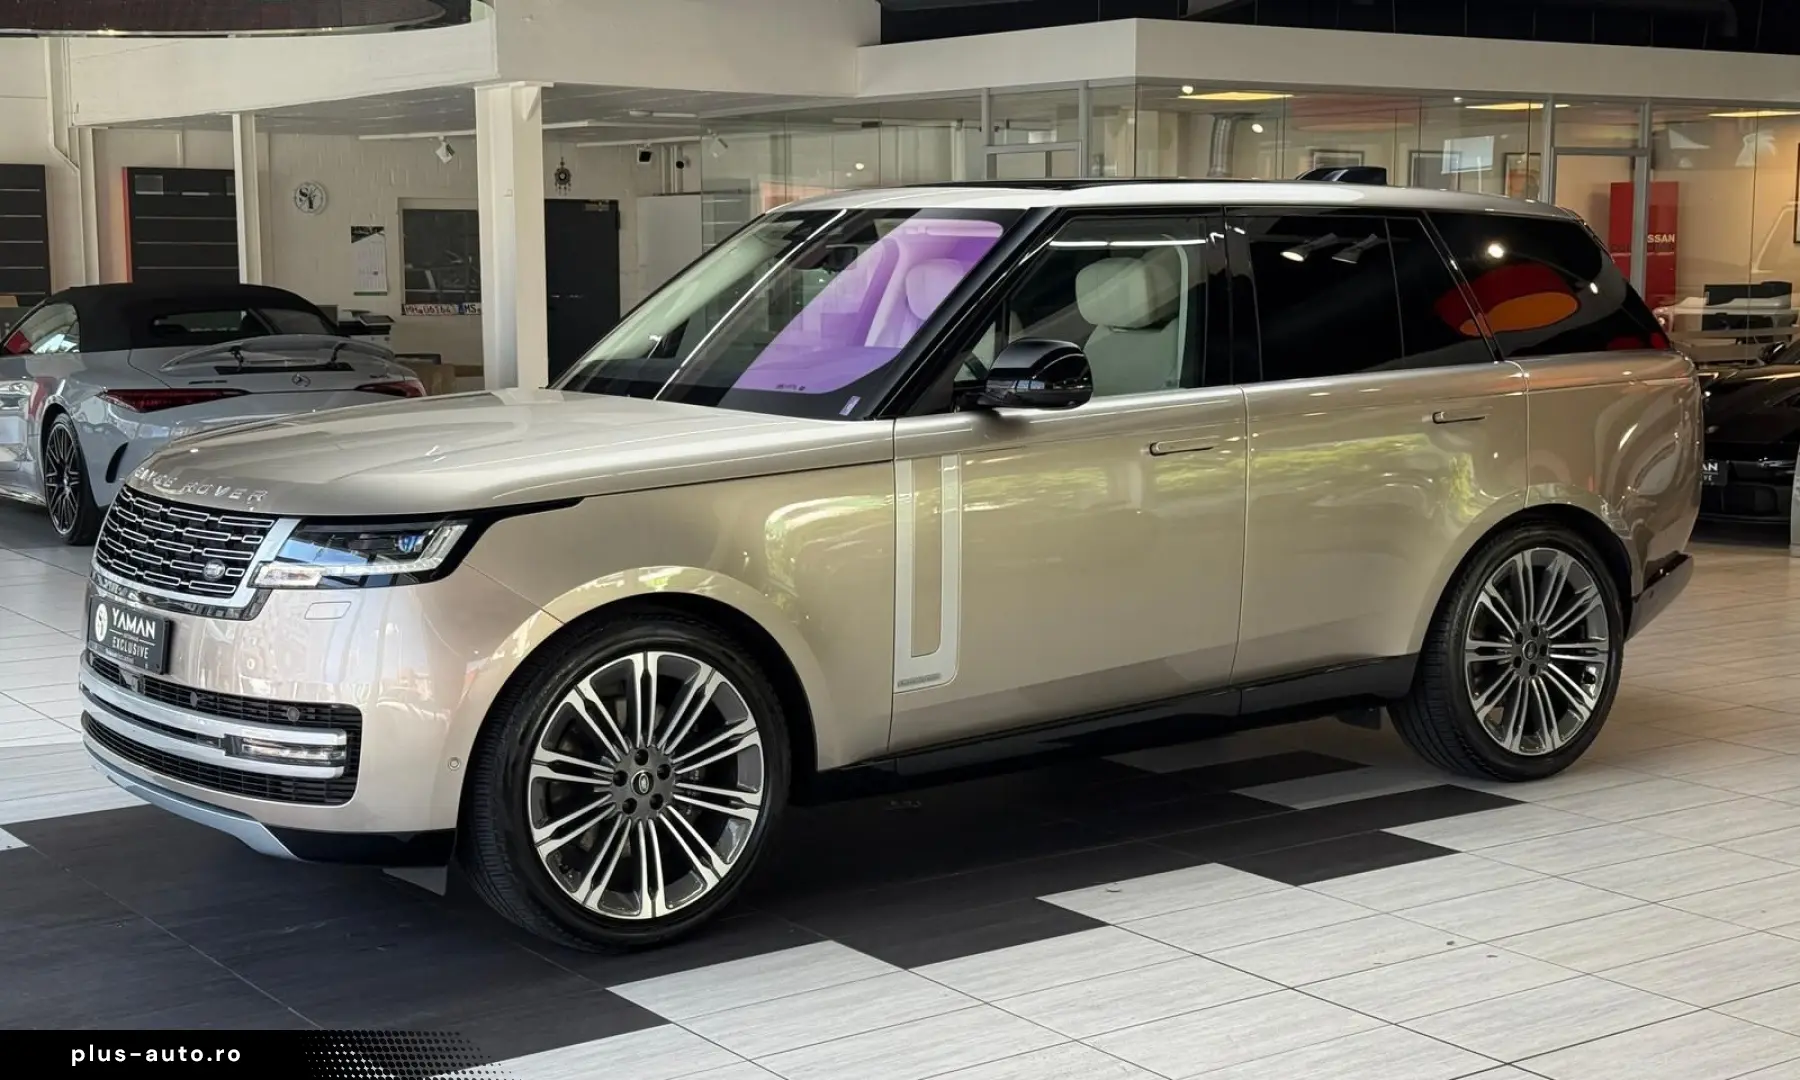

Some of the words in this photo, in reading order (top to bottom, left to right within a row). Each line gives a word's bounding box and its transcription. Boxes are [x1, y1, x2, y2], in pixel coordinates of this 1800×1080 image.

[1647, 233, 1676, 244] SSAN
[180, 482, 269, 505] ROVER
[112, 607, 156, 640] YAMAN
[112, 636, 149, 659] EXCLUSIVE
